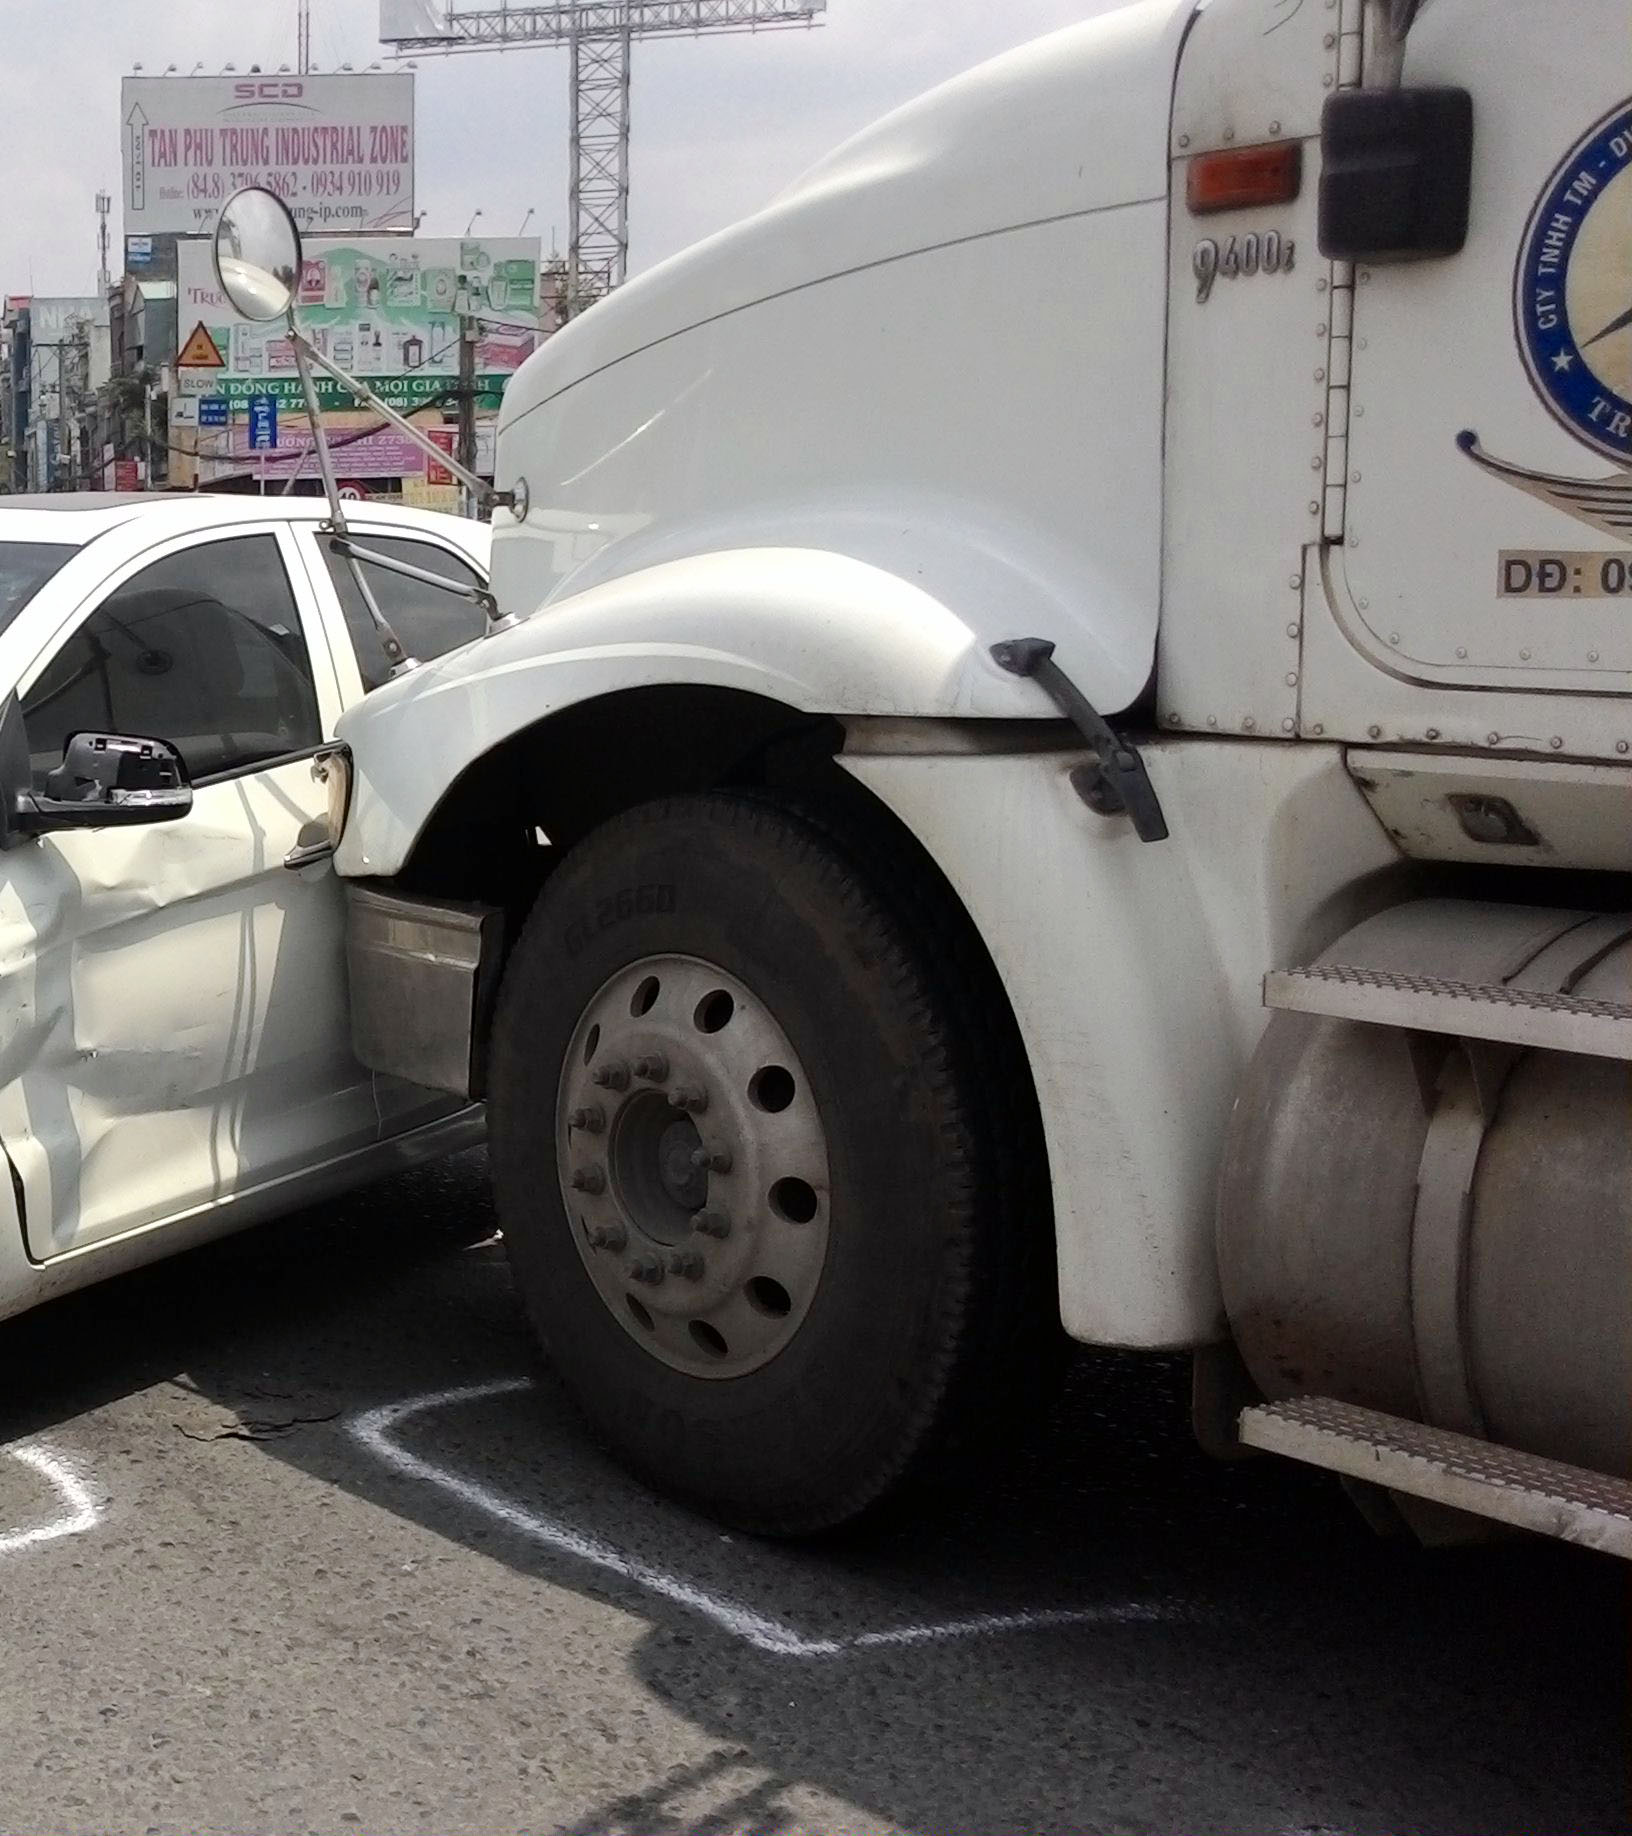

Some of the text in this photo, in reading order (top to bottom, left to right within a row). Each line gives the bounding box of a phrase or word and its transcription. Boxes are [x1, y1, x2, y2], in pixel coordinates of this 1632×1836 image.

[234, 83, 304, 99] SCD
[149, 125, 409, 168] TAN PHU TRUNG INDUSTRIAL ZONE
[311, 171, 344, 197] 0934
[348, 170, 372, 197] 910
[376, 169, 400, 196] 919
[1563, 169, 1598, 208] TM
[1537, 212, 1573, 277] TNHH
[1538, 287, 1561, 330] CTY
[183, 378, 214, 390] SLOW
[412, 380, 441, 393] GIA
[1503, 558, 1632, 594] DĐ: 0
